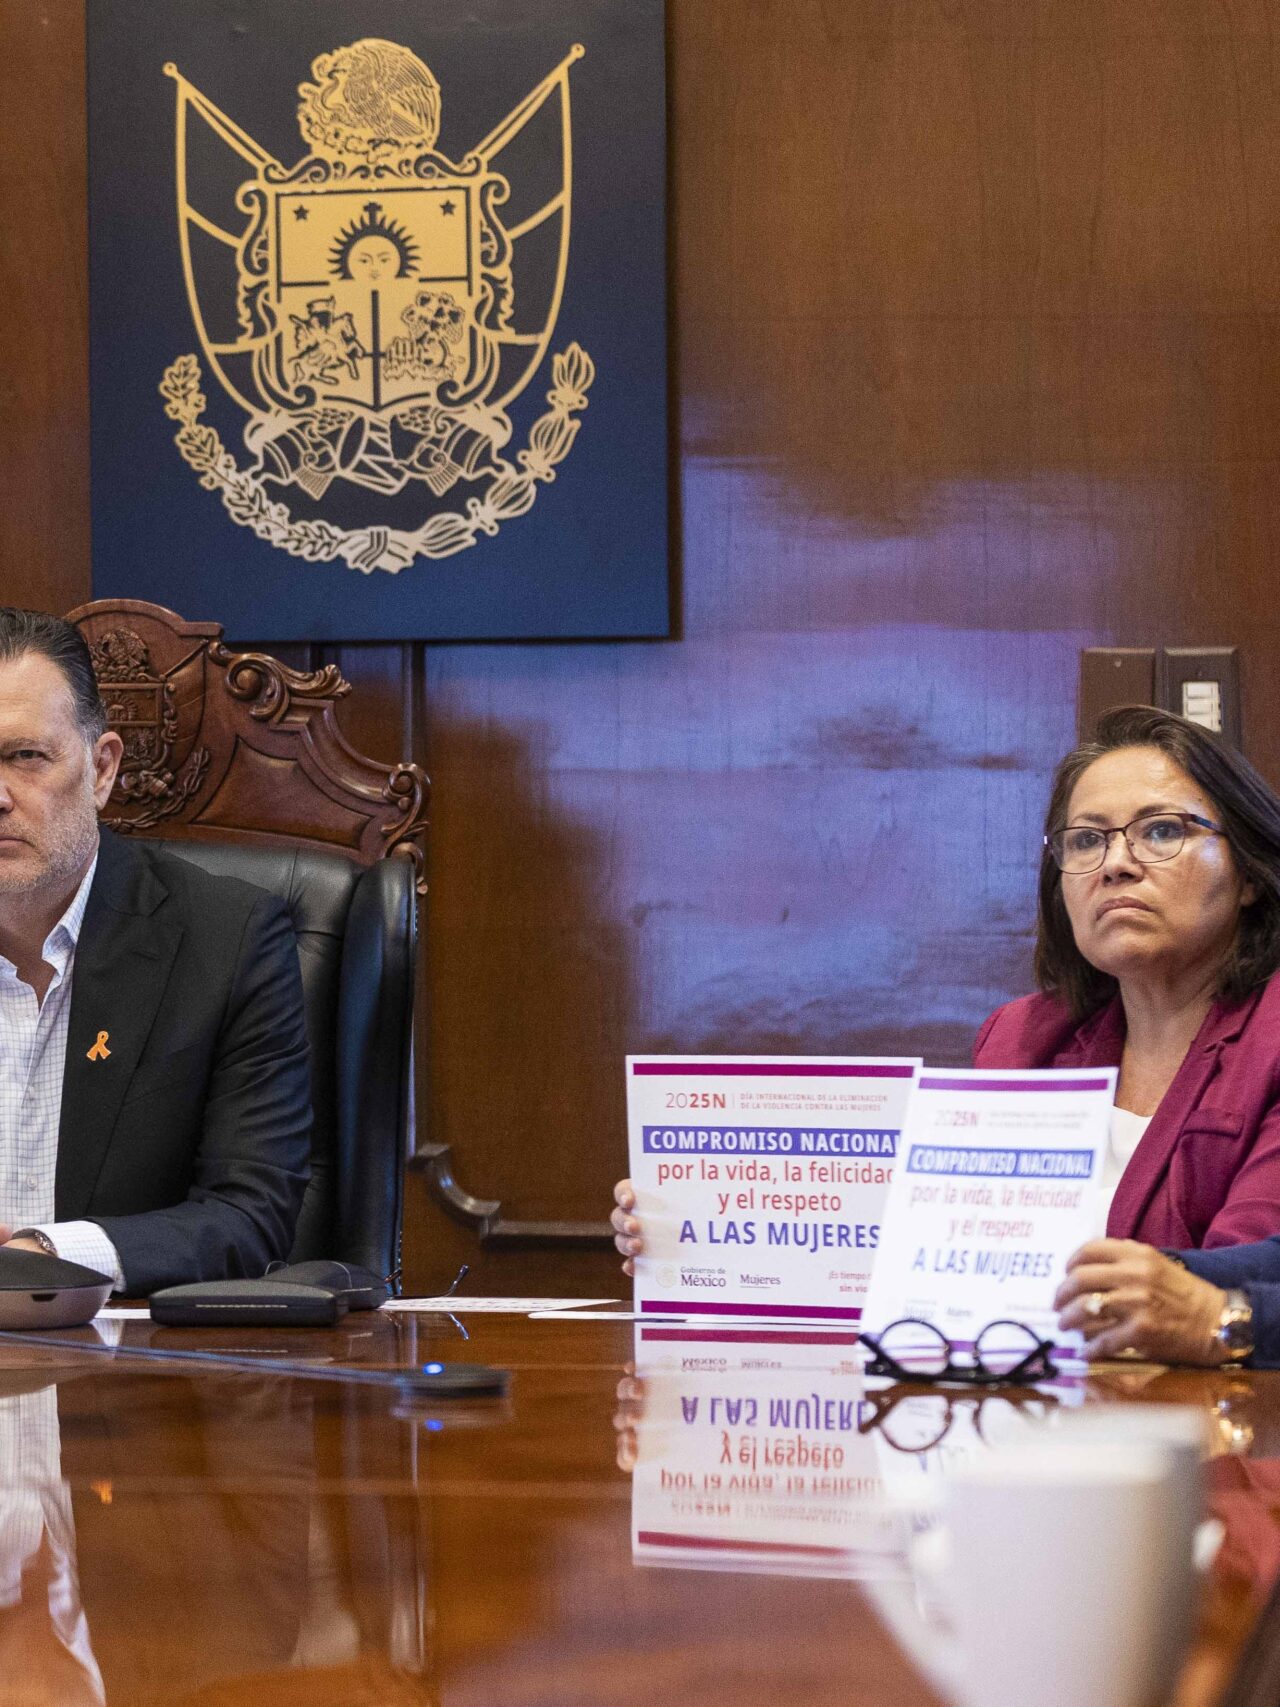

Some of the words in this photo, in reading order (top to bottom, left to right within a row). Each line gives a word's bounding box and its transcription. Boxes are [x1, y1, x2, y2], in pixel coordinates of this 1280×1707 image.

[665, 1092, 726, 1109] 2025N
[649, 1130, 793, 1151] COMPROMISO
[658, 1163, 694, 1185] por
[701, 1159, 718, 1180] la
[725, 1160, 778, 1184] vida,
[784, 1160, 802, 1182] la
[911, 1149, 1017, 1174] COMPROMISO
[1020, 1153, 1091, 1176] NACIONAL
[718, 1193, 730, 1214] y
[736, 1188, 754, 1209] el
[762, 1192, 842, 1216] respeto
[910, 1185, 940, 1208] por
[1019, 1184, 1083, 1208] felicidad
[679, 1220, 697, 1243] A
[708, 1221, 756, 1244] LAS
[767, 1222, 880, 1253] MUJERES
[981, 1219, 1033, 1241] respeto
[912, 1247, 926, 1271] A
[934, 1249, 968, 1275] LAS
[974, 1251, 1054, 1283] MUJERES
[680, 1274, 726, 1287] México
[740, 1274, 781, 1286] Mujeres
